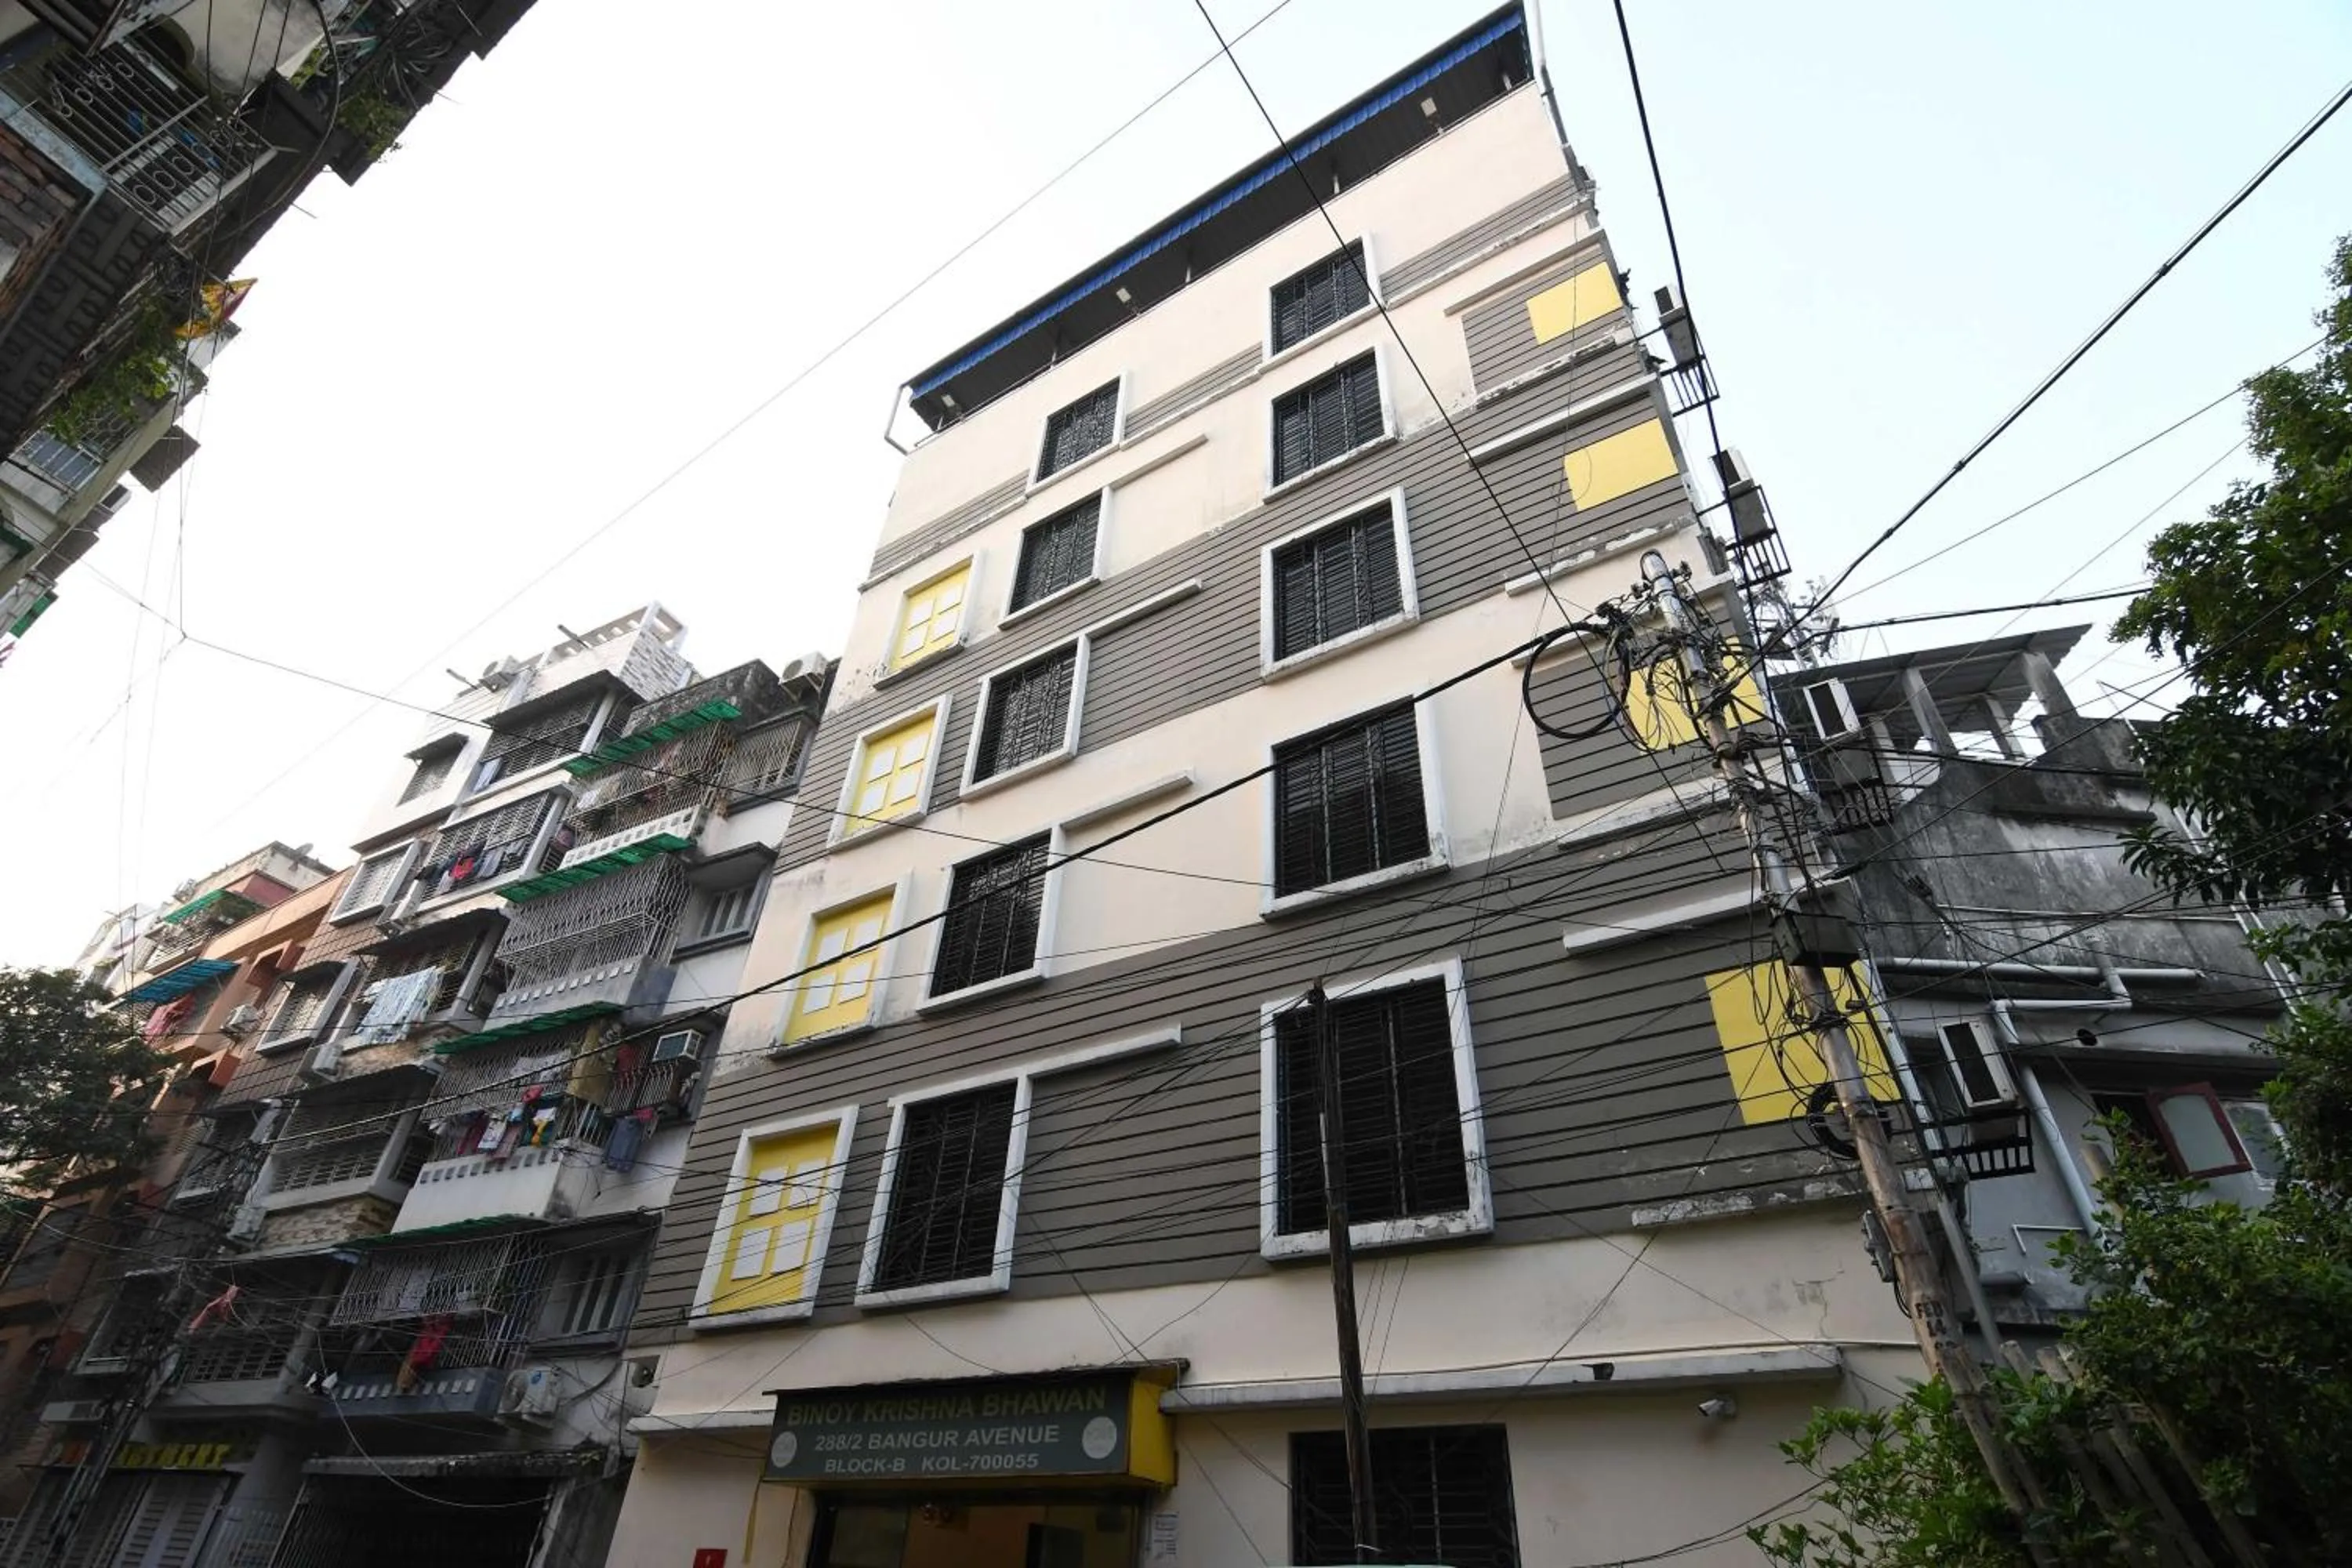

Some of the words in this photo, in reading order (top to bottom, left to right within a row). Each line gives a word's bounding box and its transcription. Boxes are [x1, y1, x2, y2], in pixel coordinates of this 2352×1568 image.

[787, 1403, 858, 1425] BINOY
[863, 1396, 973, 1421] KRISHNA
[982, 1388, 1105, 1417] BHAWAN
[815, 1434, 862, 1450] 288/2
[868, 1430, 958, 1449] BANGUR
[964, 1425, 1060, 1446] AVENUE
[825, 1458, 906, 1472] BLOCK-B
[922, 1454, 1040, 1471] KOL-700055
